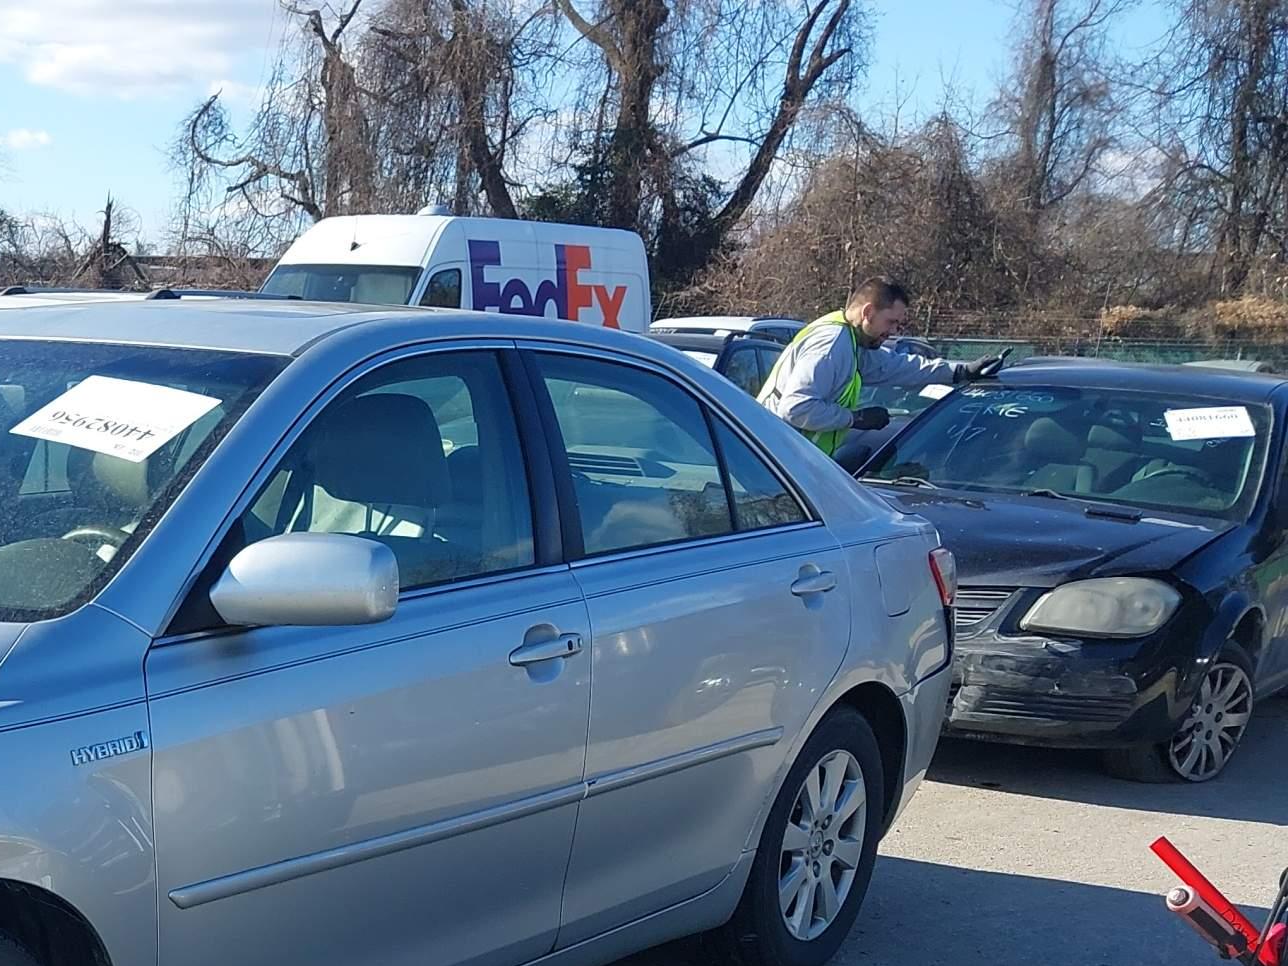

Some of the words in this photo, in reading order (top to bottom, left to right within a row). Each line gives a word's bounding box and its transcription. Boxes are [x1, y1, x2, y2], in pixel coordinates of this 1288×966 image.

[468, 239, 627, 329] FedEx
[48, 410, 156, 441] 44082956
[71, 735, 138, 766] HYBRID
